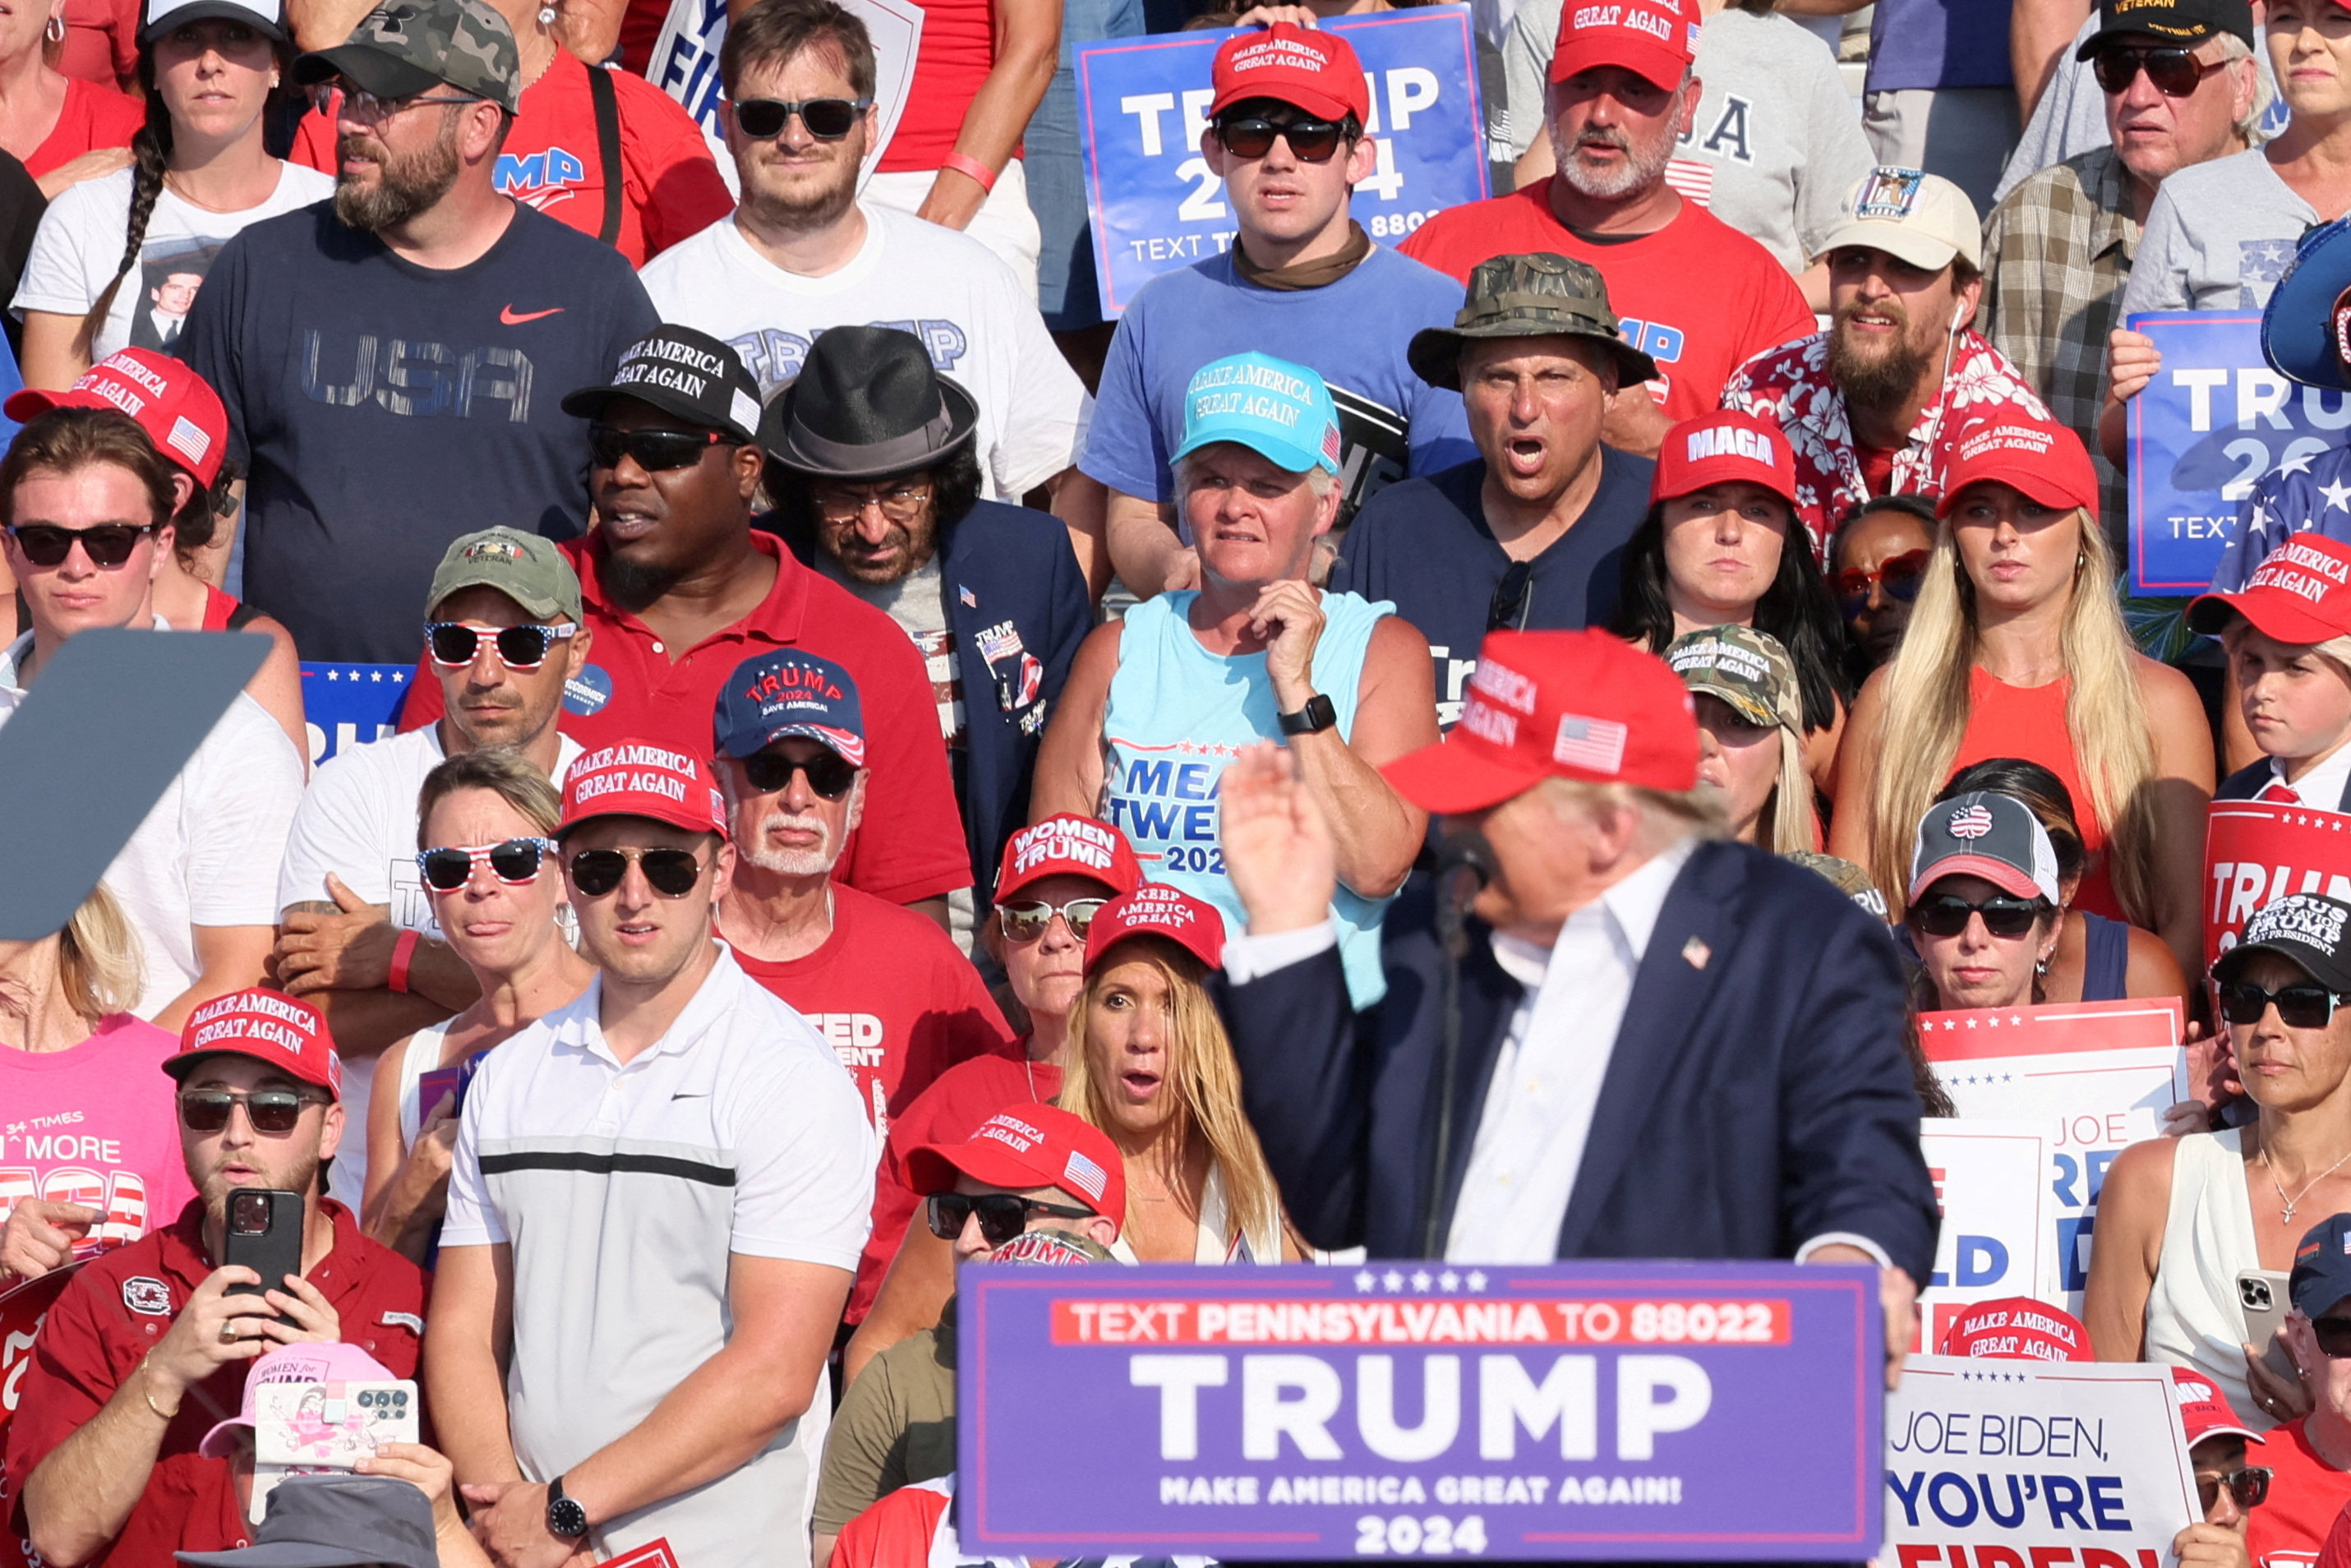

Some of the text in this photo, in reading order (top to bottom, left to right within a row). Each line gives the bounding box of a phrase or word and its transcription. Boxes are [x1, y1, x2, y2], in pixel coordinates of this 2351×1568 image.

[1573, 6, 1621, 30] GREAT
[1623, 7, 1672, 41] AGAIN
[1230, 39, 1328, 64] MAKE AMERICA
[1233, 53, 1321, 73] GREAT AGAIN
[1175, 138, 1404, 222] 24
[1370, 210, 1441, 238] 880
[1130, 234, 1202, 262] TEXT
[641, 338, 725, 380] AMERICA
[300, 328, 535, 424] USA
[643, 365, 708, 400] AGAIN
[1189, 363, 1313, 407] MAKE AMERICA
[90, 377, 146, 418] AGAIN
[1195, 392, 1301, 429] GREAT AGAIN
[1687, 425, 1775, 469] MAGA
[1959, 425, 2055, 454] MAKE AMERICA
[1962, 437, 2048, 462] GREAT AGAIN
[2267, 568, 2330, 604] AGAIN
[1669, 641, 1771, 674] MAKE AMERICA
[1672, 654, 1761, 683] GREAT AGAIN
[744, 666, 845, 703] TRUMP
[776, 688, 814, 703] 2024
[762, 702, 785, 717] SAVE
[568, 744, 698, 783] MAKE AMERICA
[575, 771, 687, 805] GREAT AGAIN
[1013, 818, 1117, 855] WOMEN
[1014, 837, 1113, 875] TRUMP
[1165, 845, 1227, 876] 202
[1134, 888, 1181, 902] KEEP
[2255, 894, 2349, 924] JESUS
[1115, 903, 1196, 924] AMERICA
[1124, 912, 1185, 929] GREAT
[2247, 915, 2342, 944] TRUMP
[2285, 906, 2343, 935] SAVIOR
[2268, 929, 2335, 957] PRESIDENT
[190, 993, 317, 1037] MAKE AMERICA
[194, 1017, 305, 1056] GREAT AGAIN
[6, 1110, 85, 1136] 34 TIMES
[2053, 1112, 2129, 1147] JOE
[25, 1134, 122, 1164] MORE
[982, 1127, 1031, 1154] AGAIN
[1070, 1302, 1773, 1343] TEXT PENNSYLVANIA TO 88022
[1961, 1311, 2008, 1338] MAKE
[2009, 1311, 2077, 1348] AMERICA
[1969, 1335, 2069, 1363] GREAT AGAIN
[260, 1362, 316, 1379] WOMEN for
[1130, 1354, 1712, 1462] TRUMP
[1890, 1410, 2109, 1463] JOE BIDEN,
[1159, 1476, 1682, 1505] MAKE AMERICA GREAT AGAIN!
[1883, 1469, 2134, 1532] YOU'RE
[1355, 1515, 1487, 1555] 2024
